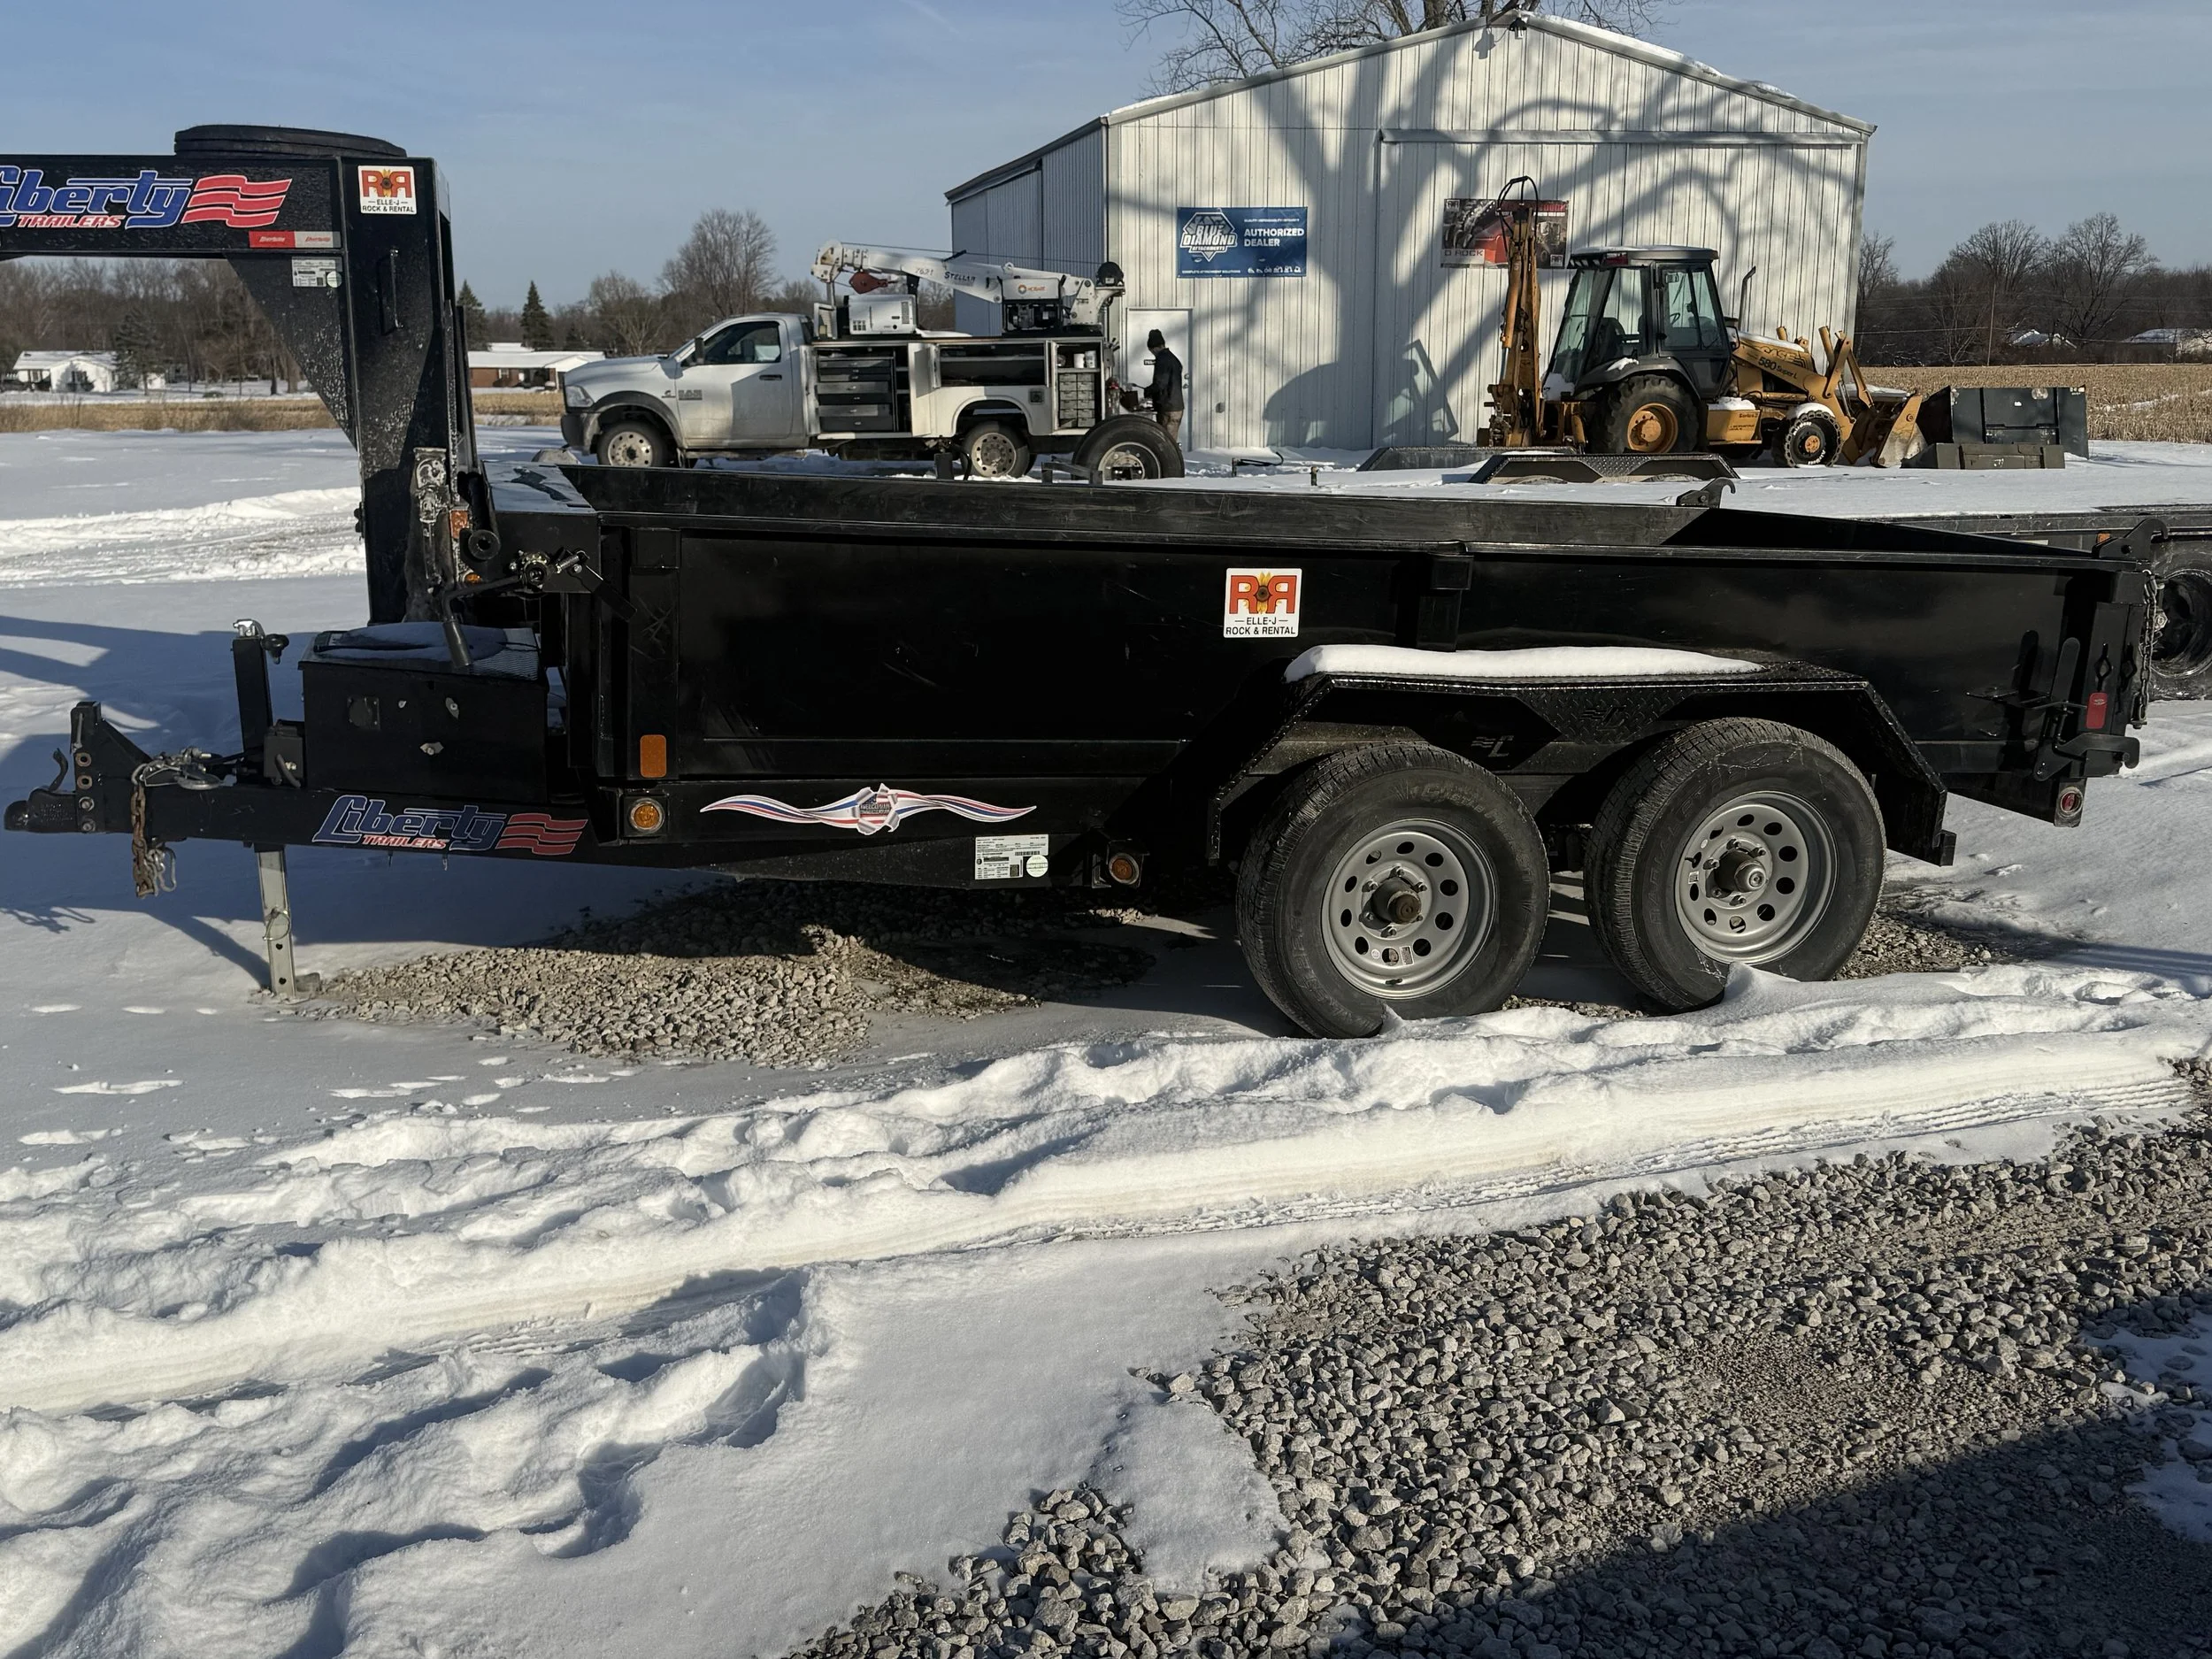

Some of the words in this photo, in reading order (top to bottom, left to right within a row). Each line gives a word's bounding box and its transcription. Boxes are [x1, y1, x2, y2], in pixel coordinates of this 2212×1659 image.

[18, 215, 126, 228] TRAILERS
[1196, 225, 1224, 235] BLUE
[1244, 228, 1305, 237] AUTHORIZED
[1183, 234, 1235, 245] DIAMOND
[1758, 356, 1777, 370] 580
[311, 795, 507, 851] Liberty
[361, 834, 449, 849] TRAILERS
